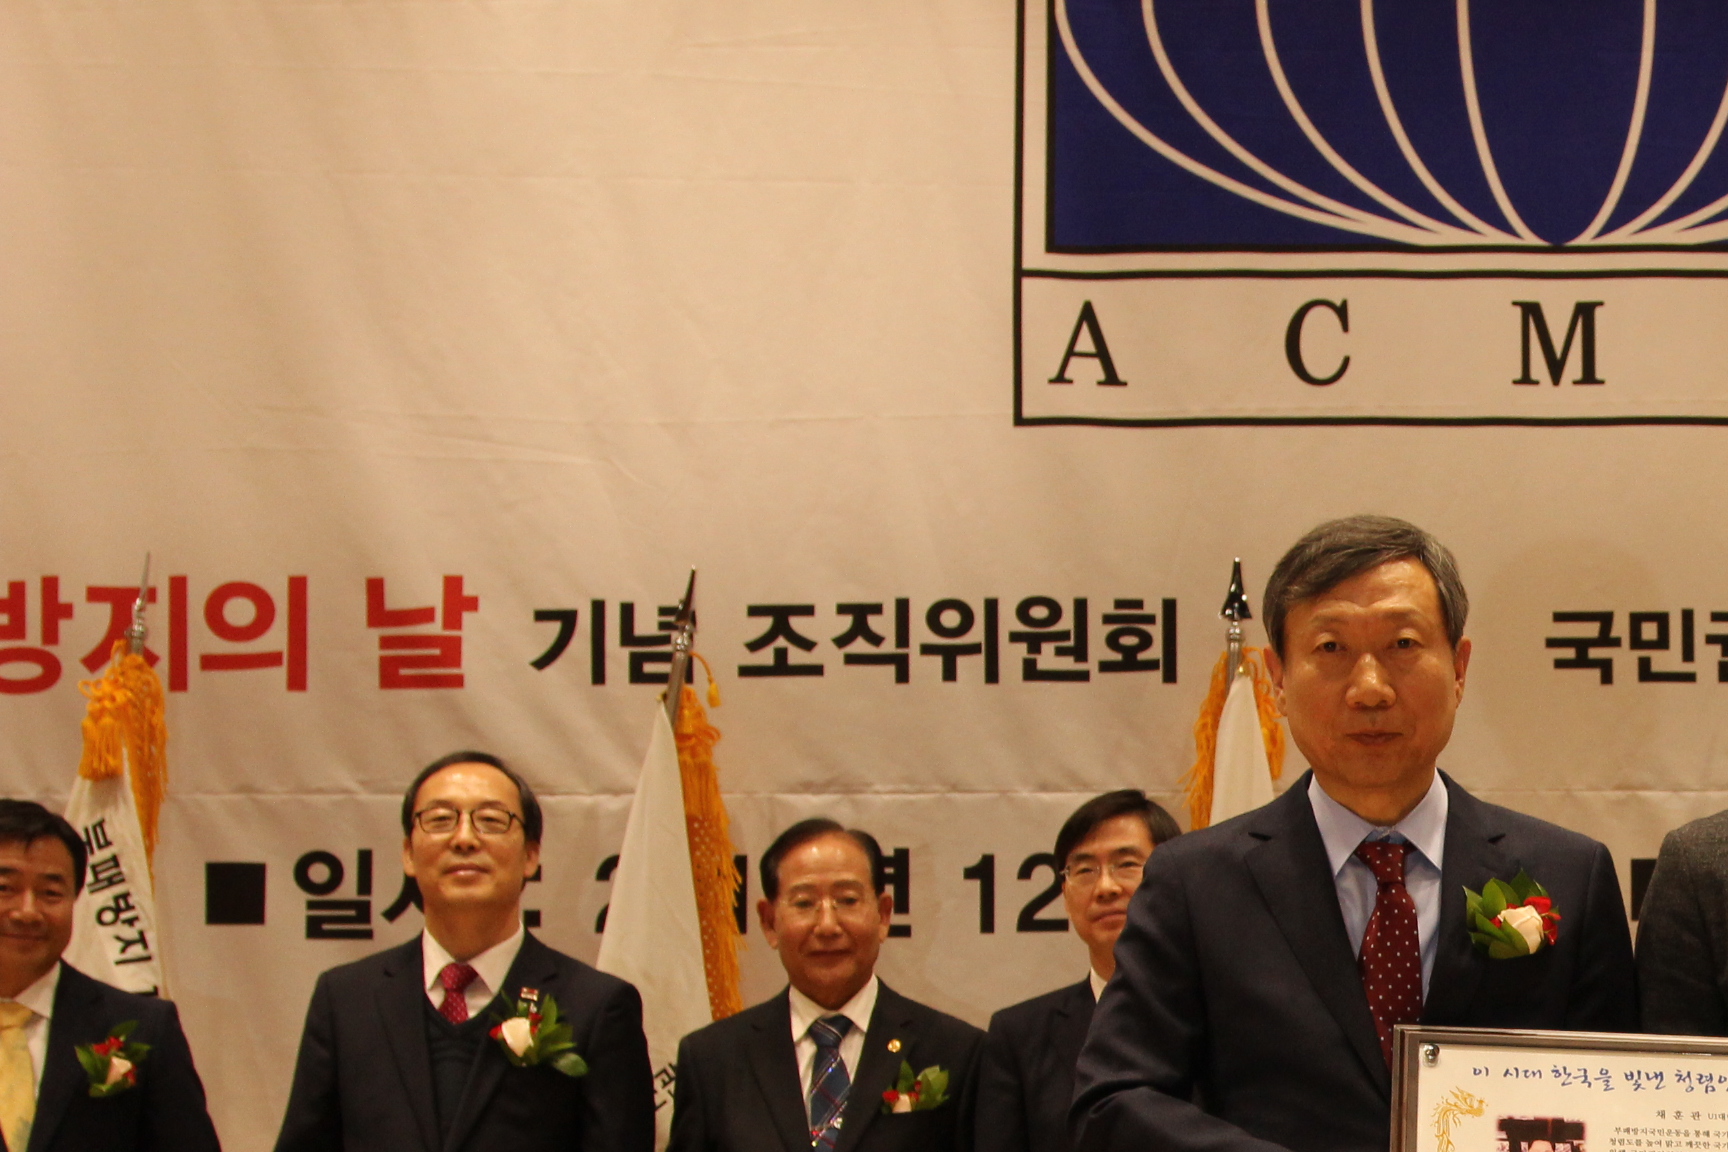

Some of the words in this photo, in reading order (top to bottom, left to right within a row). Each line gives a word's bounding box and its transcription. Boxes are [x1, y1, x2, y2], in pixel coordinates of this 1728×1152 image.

[366, 574, 479, 689] 날
[529, 598, 696, 684] 기념
[738, 596, 1178, 684] 조직위원회
[1472, 1066, 1489, 1078] 이
[1503, 1067, 1542, 1080] 시대
[1551, 1065, 1615, 1092] 한국을
[1624, 1070, 1666, 1091] 빛낸
